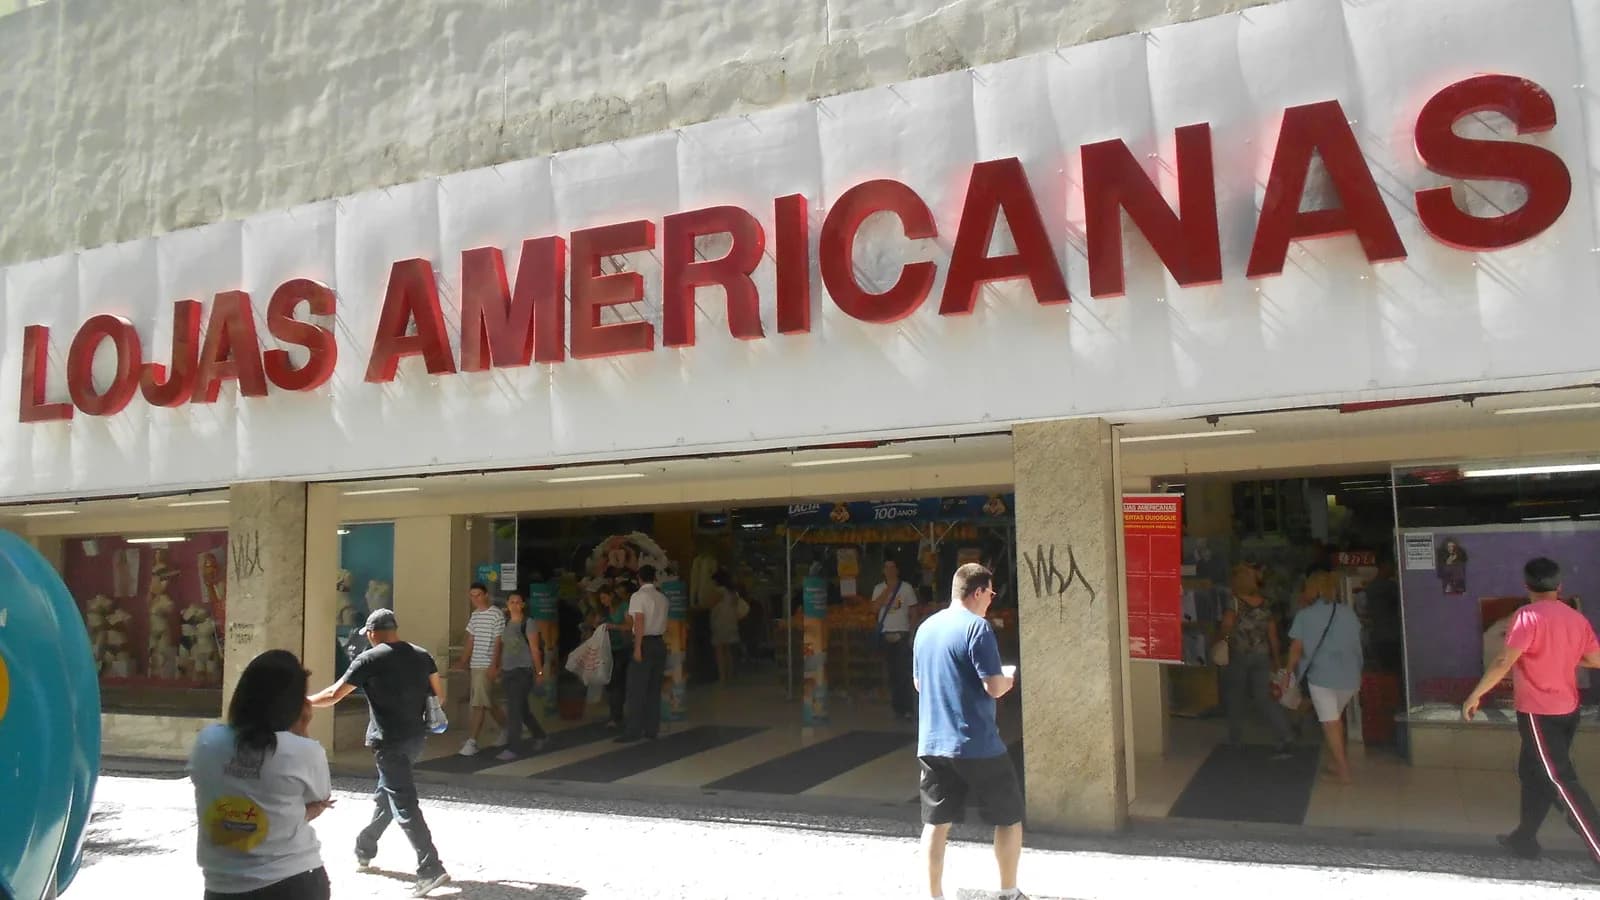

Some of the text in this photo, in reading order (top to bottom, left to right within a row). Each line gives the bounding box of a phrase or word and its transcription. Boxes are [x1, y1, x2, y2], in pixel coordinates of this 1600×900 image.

[19, 73, 1571, 423] LOJAS AMERICANAS
[874, 507, 896, 519] 100
